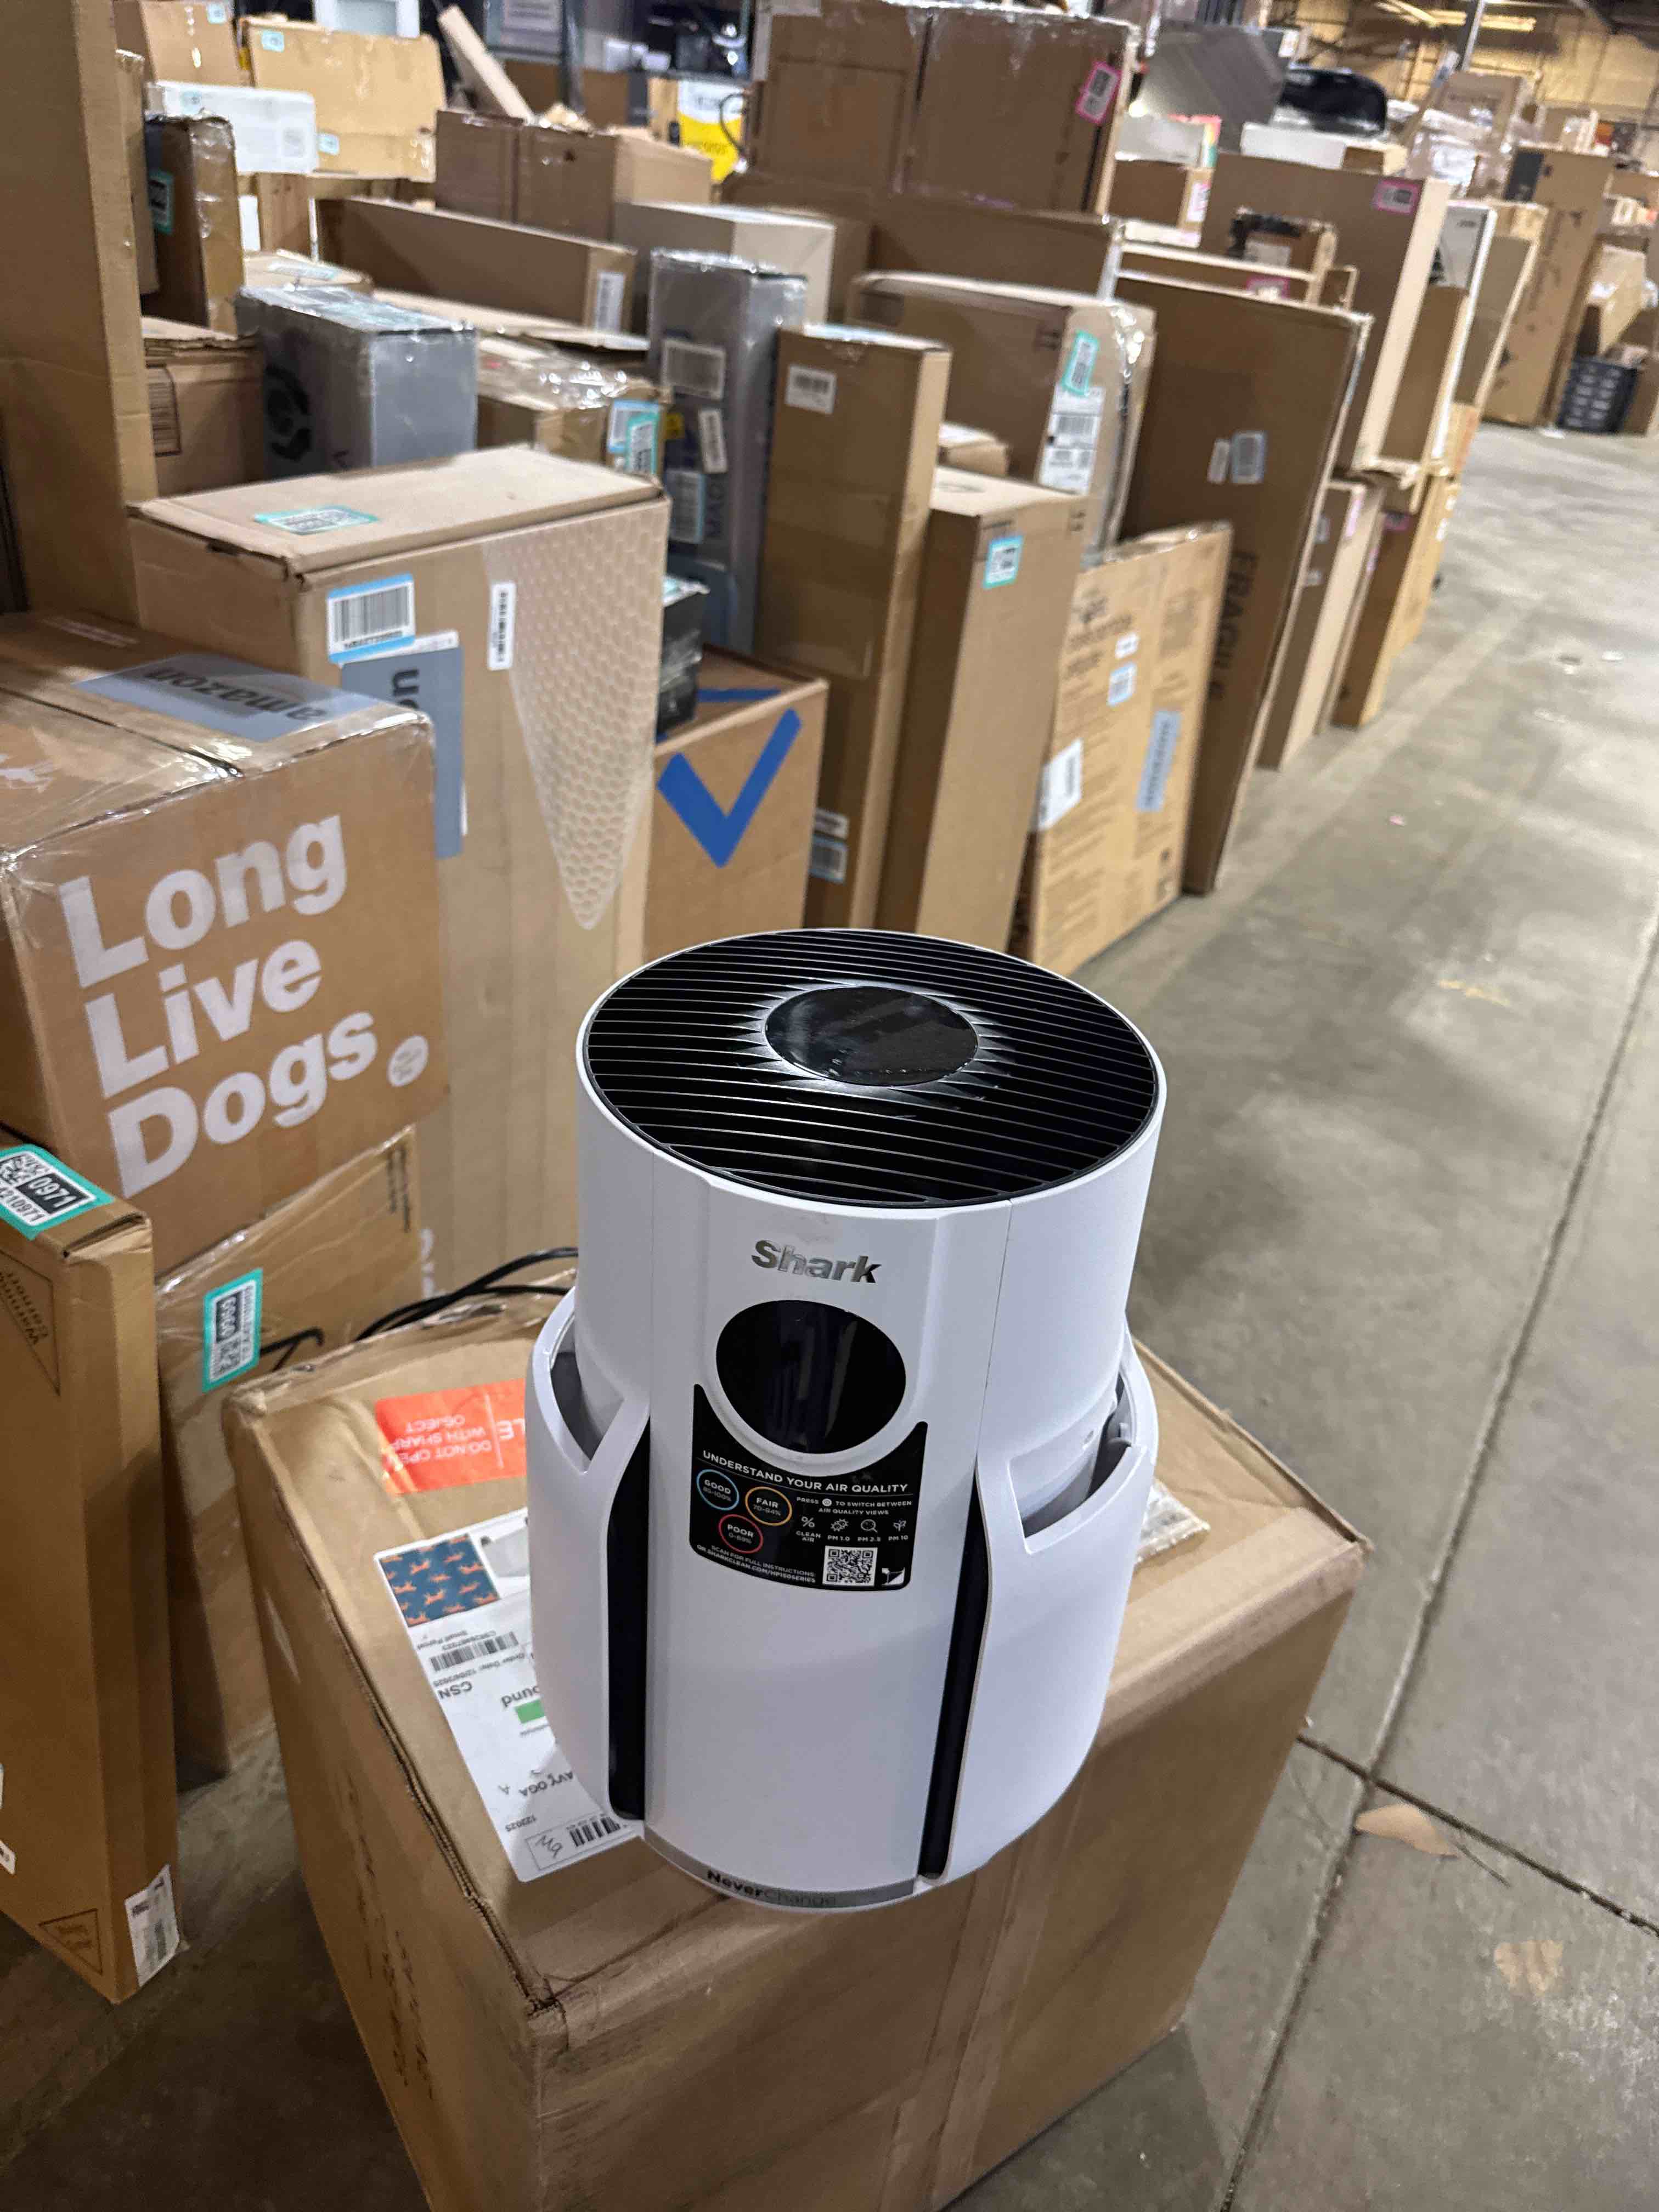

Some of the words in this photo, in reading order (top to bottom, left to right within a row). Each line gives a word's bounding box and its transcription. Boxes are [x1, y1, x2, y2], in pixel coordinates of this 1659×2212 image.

[142, 667, 329, 720] amazon
[58, 814, 347, 989] Long
[84, 939, 322, 1100] Live
[108, 1011, 378, 1199] Dogs
[29, 1177, 77, 1208] 0971
[751, 1239, 883, 1283] Shark
[405, 1414, 465, 1434] OBJECT
[447, 1426, 486, 1441] WITH
[436, 1445, 465, 1459] NOT
[468, 1440, 492, 1452] DO
[703, 1450, 783, 1482] UNDERSTAND
[786, 1477, 822, 1490] YOUR
[825, 1483, 848, 1492] AIR
[851, 1483, 909, 1493] QUALITY
[704, 1479, 731, 1494] GOOD
[756, 1497, 778, 1508] FAIR
[727, 1524, 754, 1538] POOR
[795, 1530, 821, 1539] CLEAN
[711, 1545, 730, 1556] SCAN
[730, 1553, 744, 1561] FOR
[745, 1557, 762, 1567] FULL
[438, 1681, 472, 1699] CSN
[501, 1685, 540, 1707] ound
